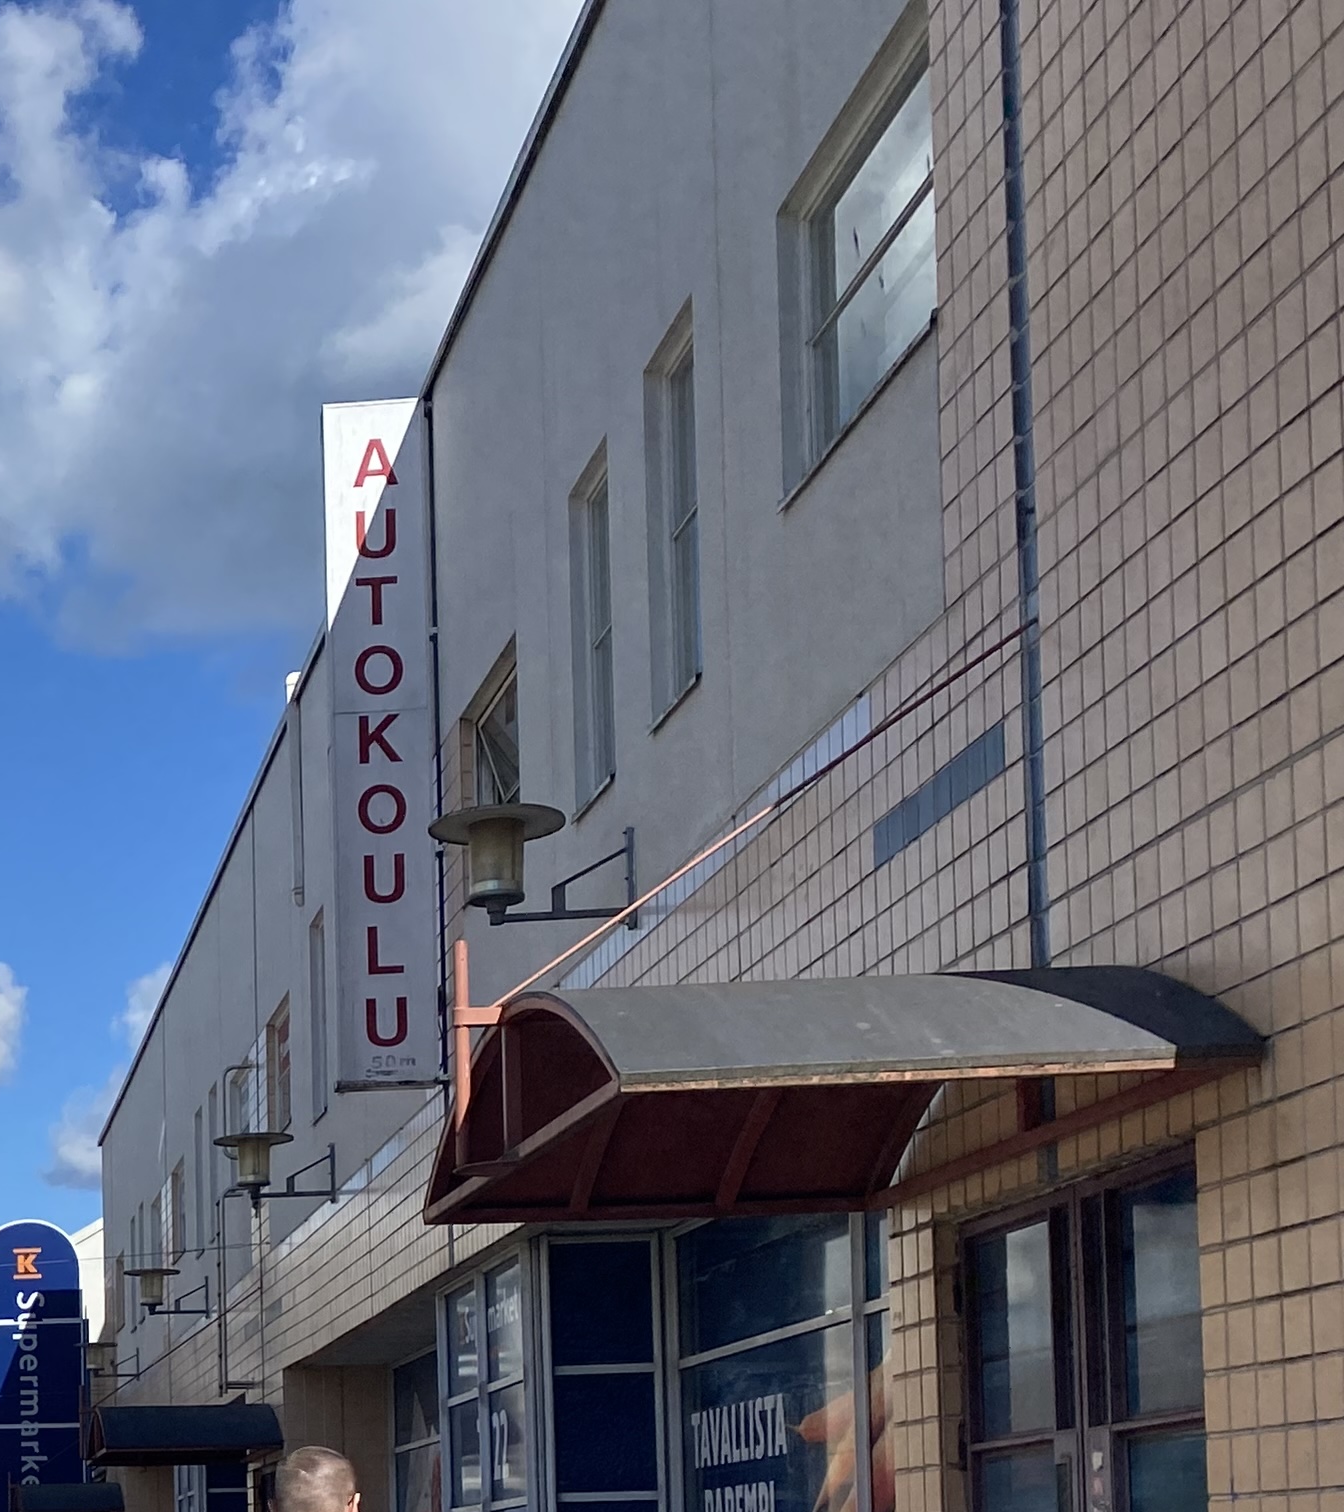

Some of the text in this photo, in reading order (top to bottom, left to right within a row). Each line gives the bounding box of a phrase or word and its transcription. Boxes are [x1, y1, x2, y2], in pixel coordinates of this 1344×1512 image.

[353, 438, 408, 1047] AUTOKOULU
[14, 1251, 40, 1276] K
[12, 1290, 49, 1487] Supermarke
[691, 1392, 787, 1468] TAVALLISTA
